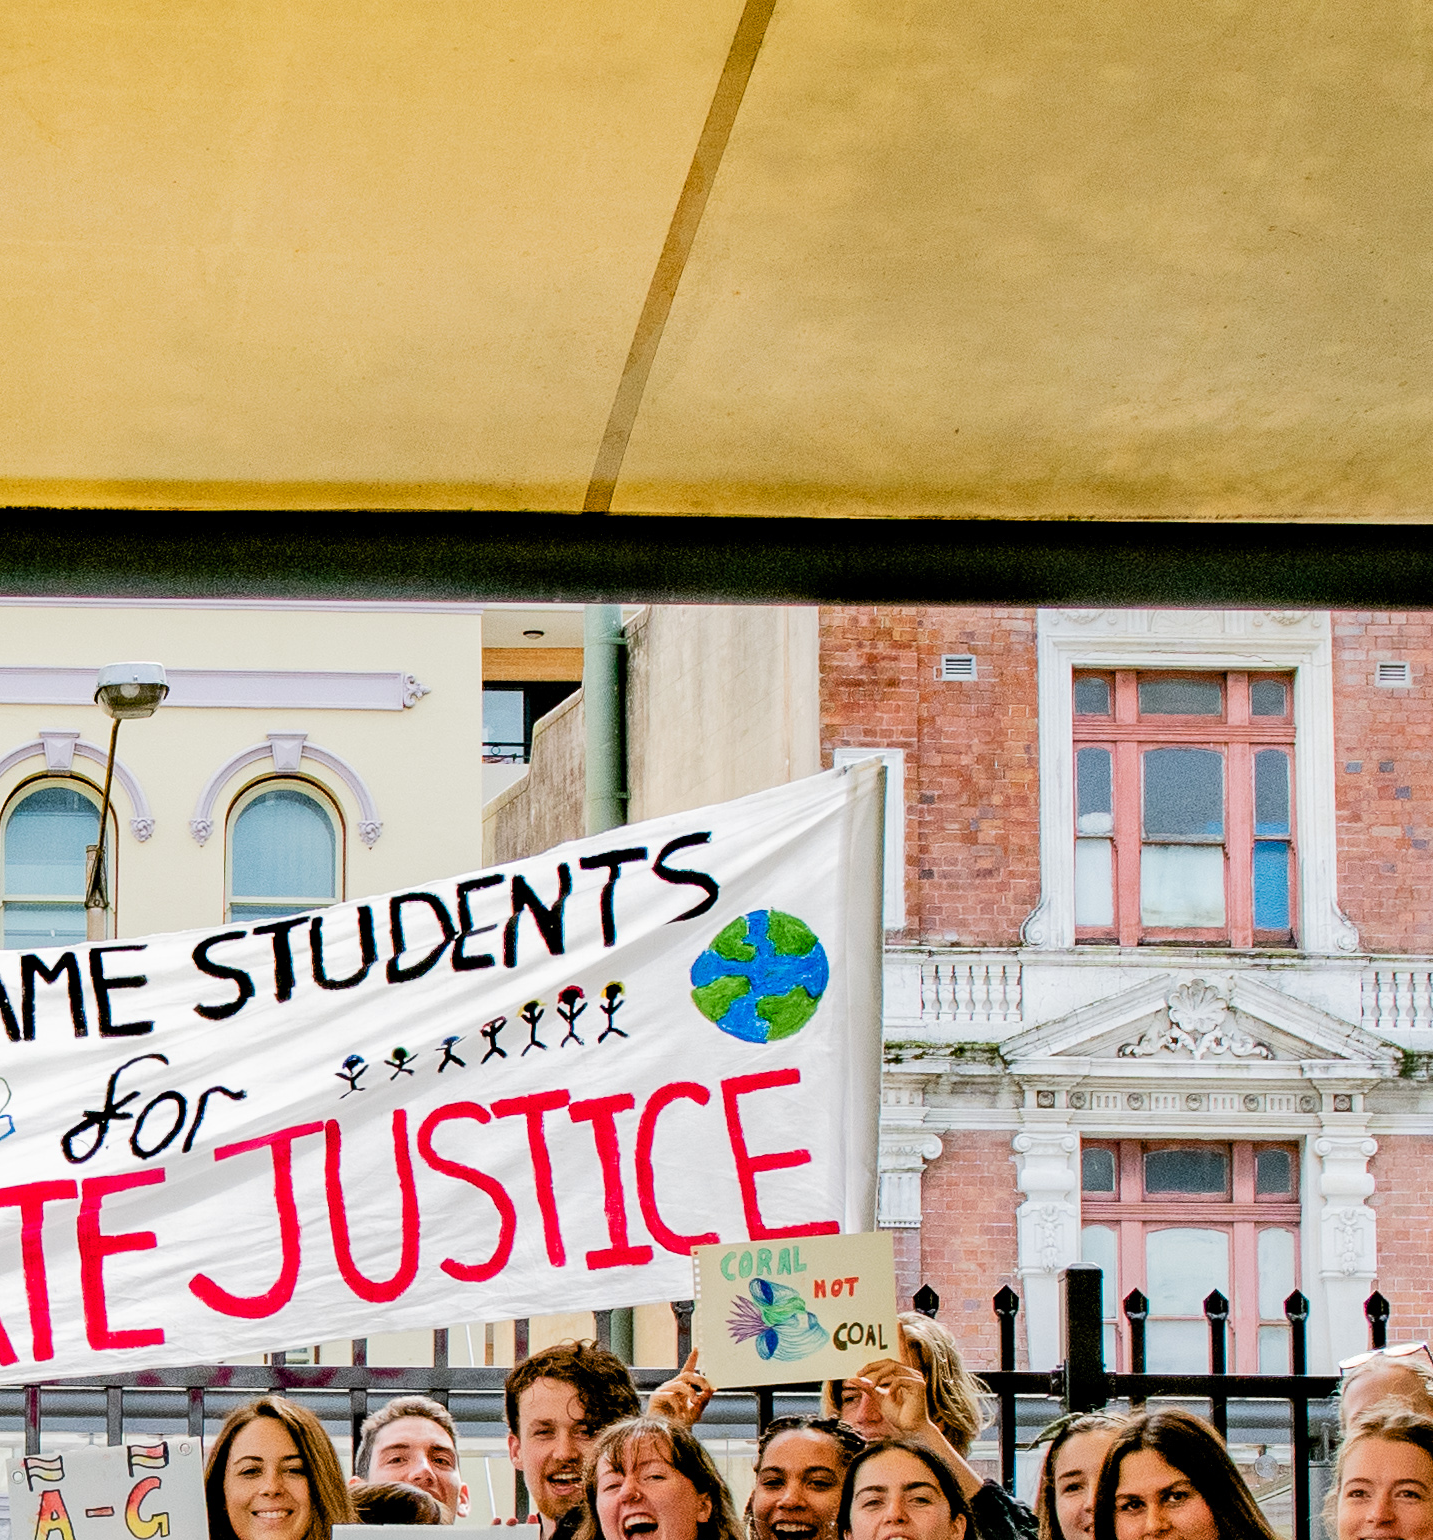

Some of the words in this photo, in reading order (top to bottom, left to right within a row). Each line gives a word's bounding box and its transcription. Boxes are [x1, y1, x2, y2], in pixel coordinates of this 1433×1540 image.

[191, 830, 721, 1021] STUDENTS
[62, 1053, 246, 1164] for
[189, 1068, 839, 1317] JUSTICE
[720, 1246, 807, 1281] CORAL
[814, 1277, 859, 1298] NOT
[833, 1322, 888, 1351] COAL
